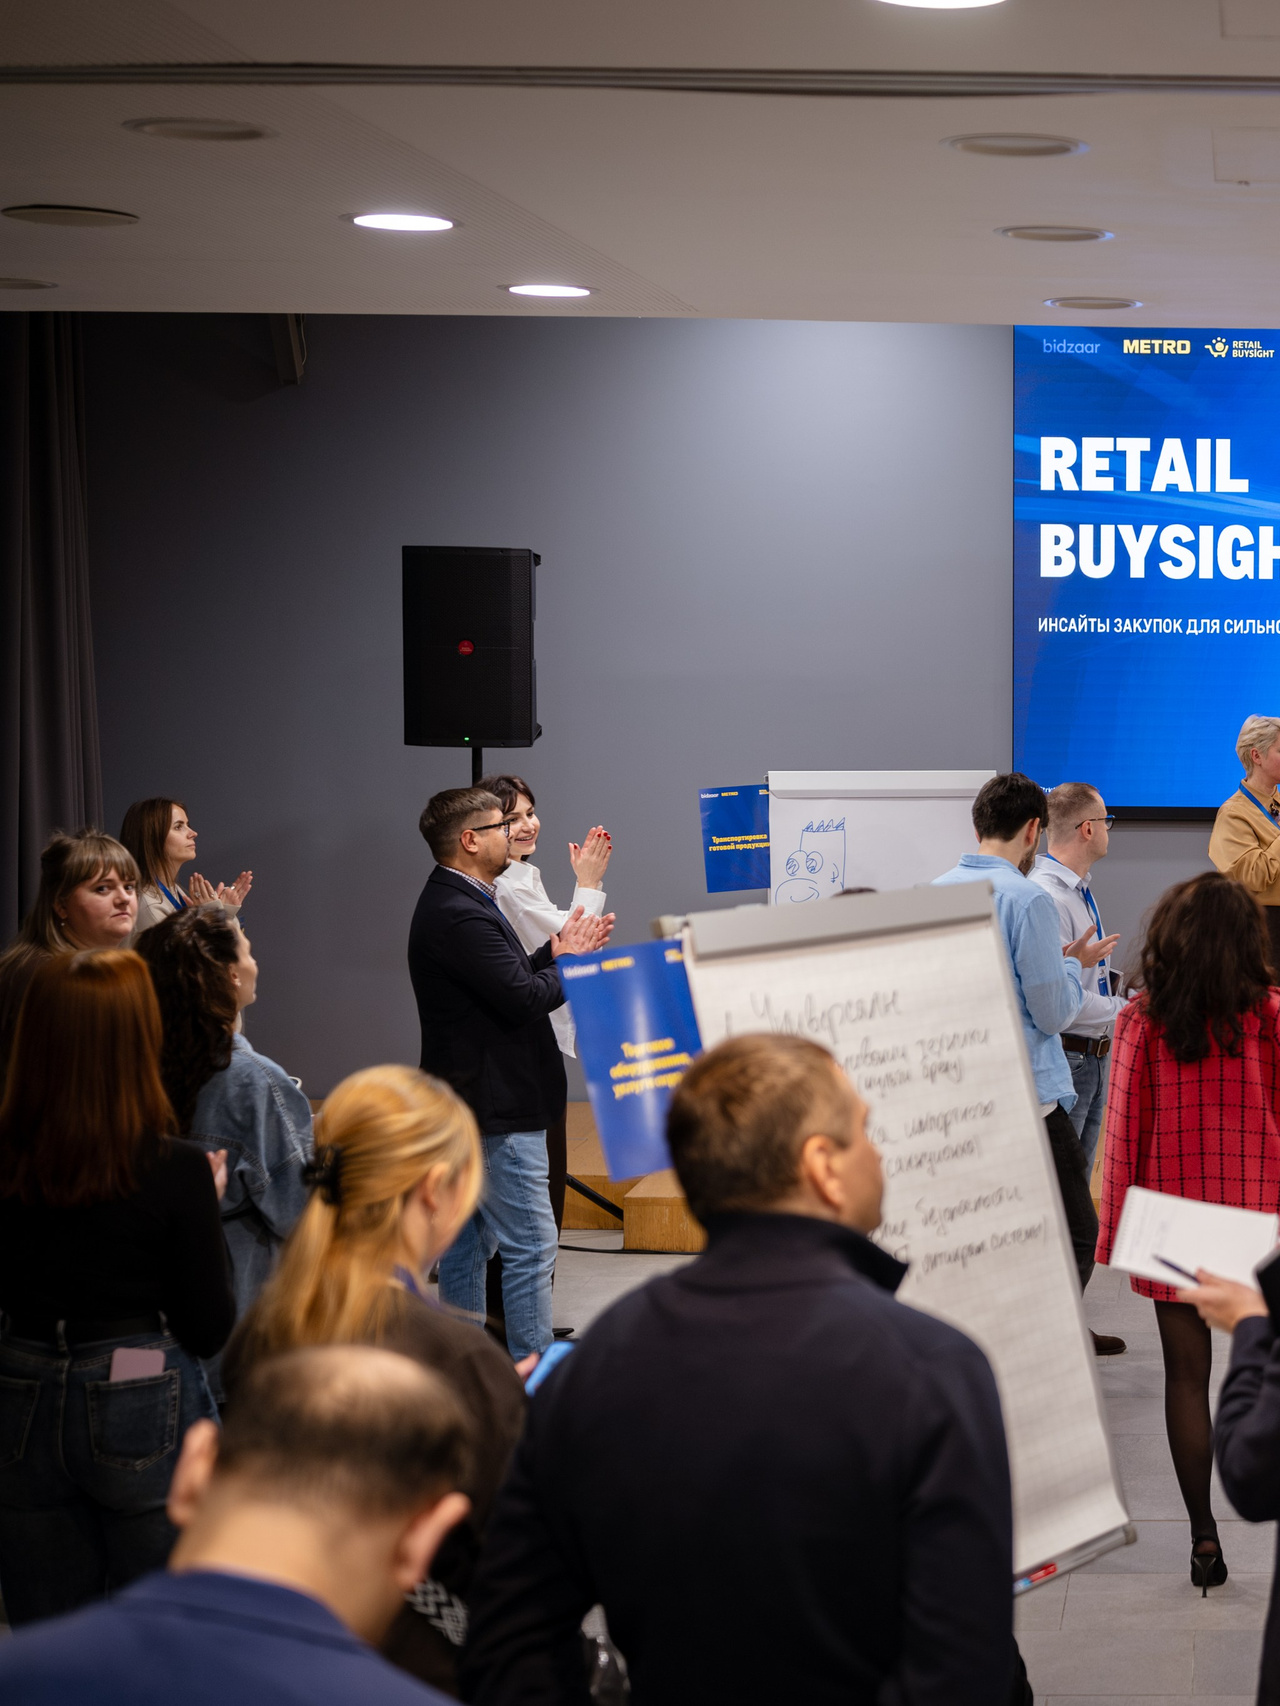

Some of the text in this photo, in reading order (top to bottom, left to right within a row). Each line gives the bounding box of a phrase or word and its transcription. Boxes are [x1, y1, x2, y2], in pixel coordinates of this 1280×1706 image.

[1043, 339, 1101, 354] bidzaar
[1123, 340, 1191, 355] METRO
[1232, 340, 1263, 350] RETAIL
[1232, 348, 1275, 359] BUYSIGHT
[1040, 436, 1249, 493] RETAIL
[1038, 614, 1110, 633] ИНСАЙТЫ
[1114, 618, 1183, 633] ЗАКУПОК
[1186, 618, 1220, 635] ДЛЯ
